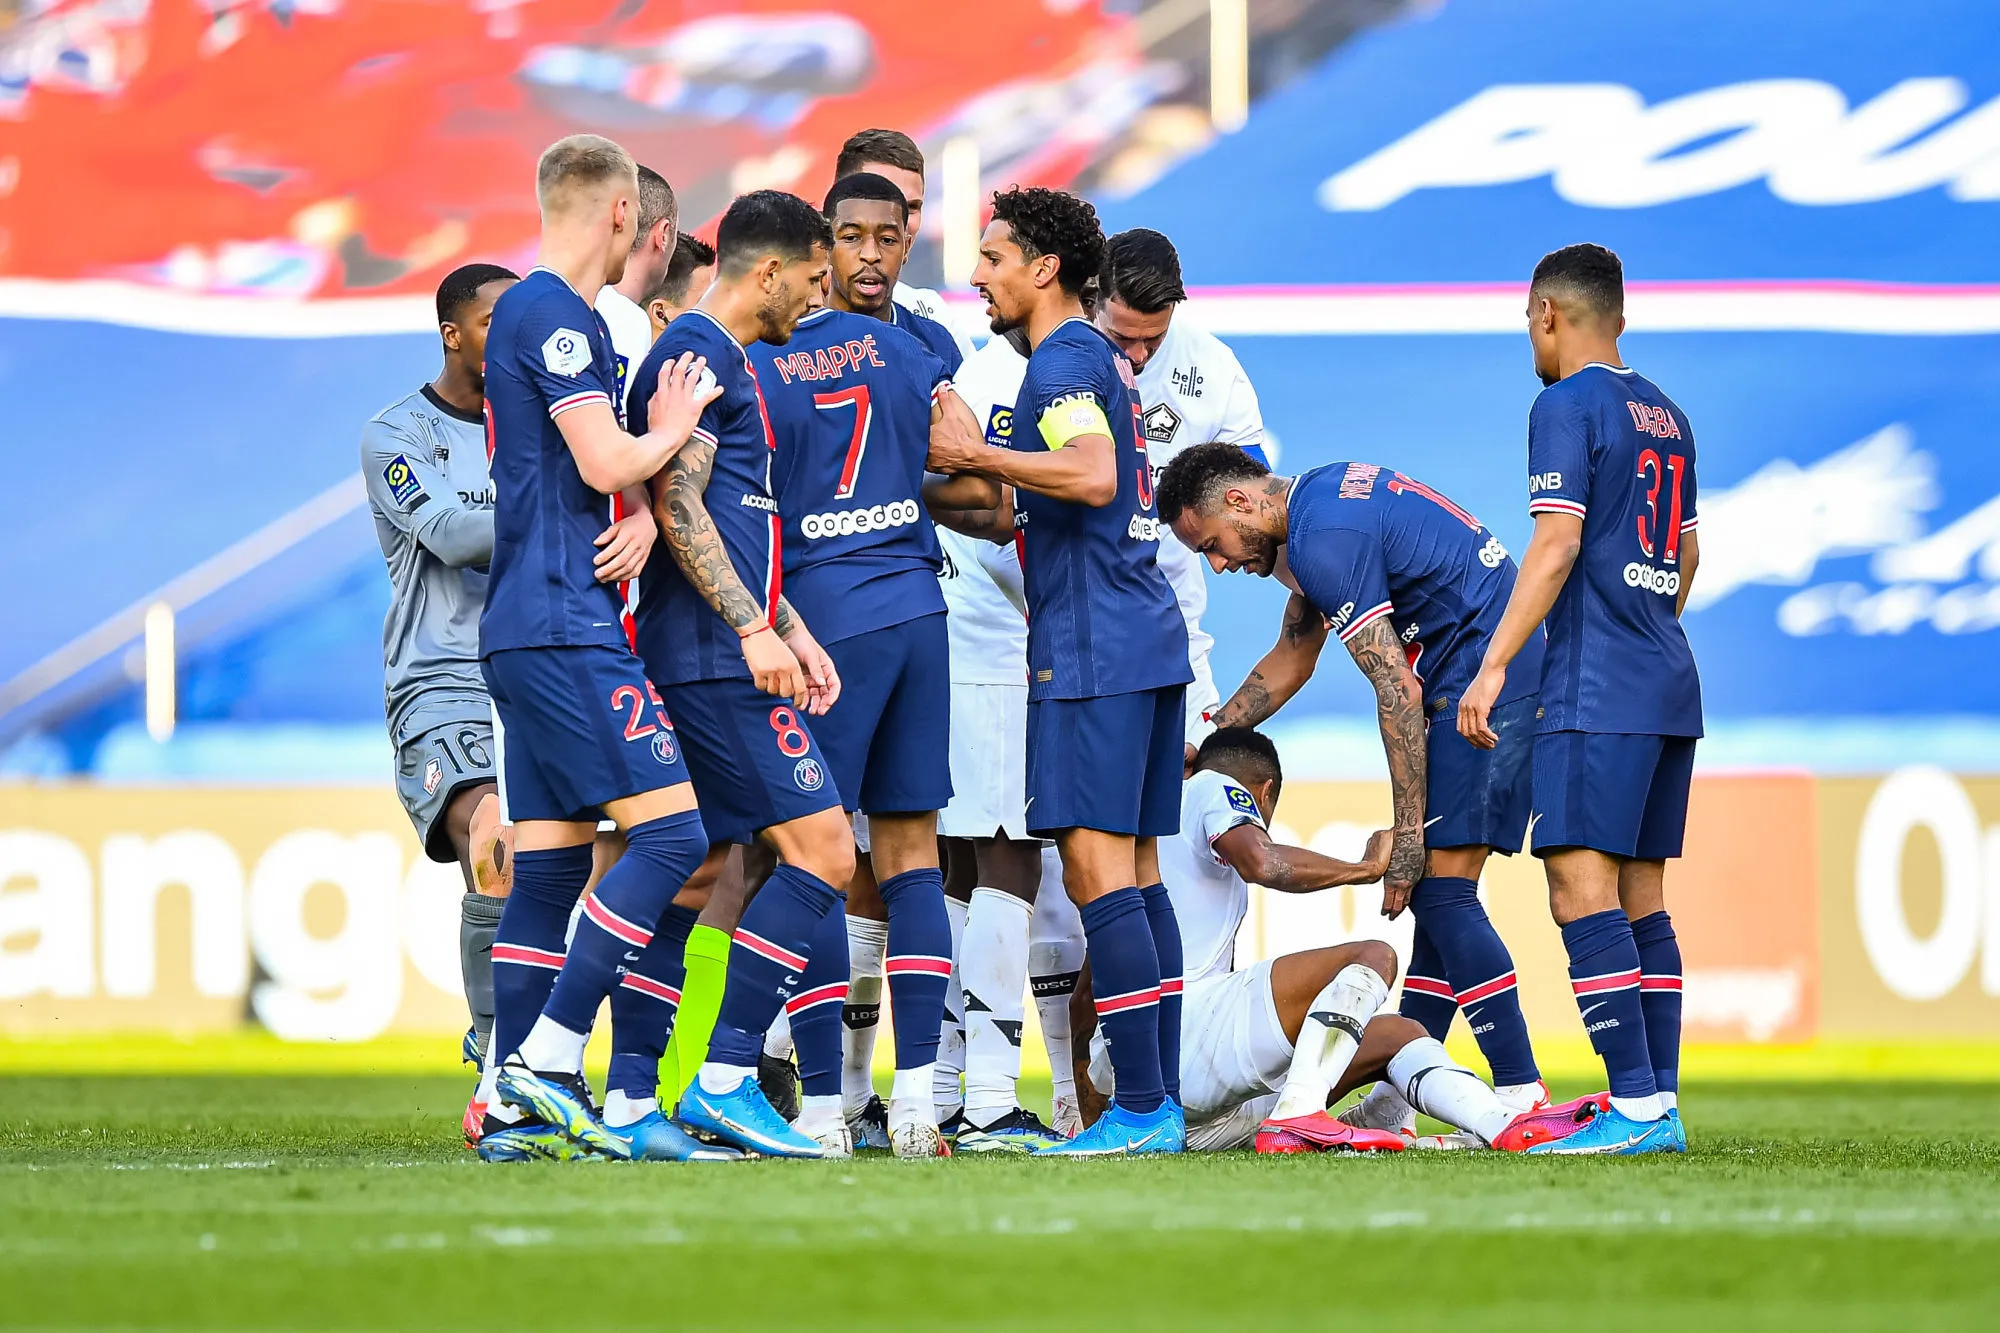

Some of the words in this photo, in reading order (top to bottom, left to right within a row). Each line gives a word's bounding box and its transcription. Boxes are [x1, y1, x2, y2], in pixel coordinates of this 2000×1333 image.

[912, 300, 934, 319] ello
[773, 334, 886, 385] MBAPPÉ
[1172, 366, 1204, 386] hello
[813, 384, 872, 500] 7
[1148, 429, 1170, 440] LOSC
[1529, 472, 1562, 493] QNB
[1637, 449, 1685, 564] 31
[801, 499, 919, 538] ooredoo
[769, 706, 810, 758] 8
[432, 731, 491, 774] 16
[1032, 979, 1072, 991] LOSC
[851, 1010, 879, 1021] LOS
[1472, 1022, 1496, 1035] ARIS
